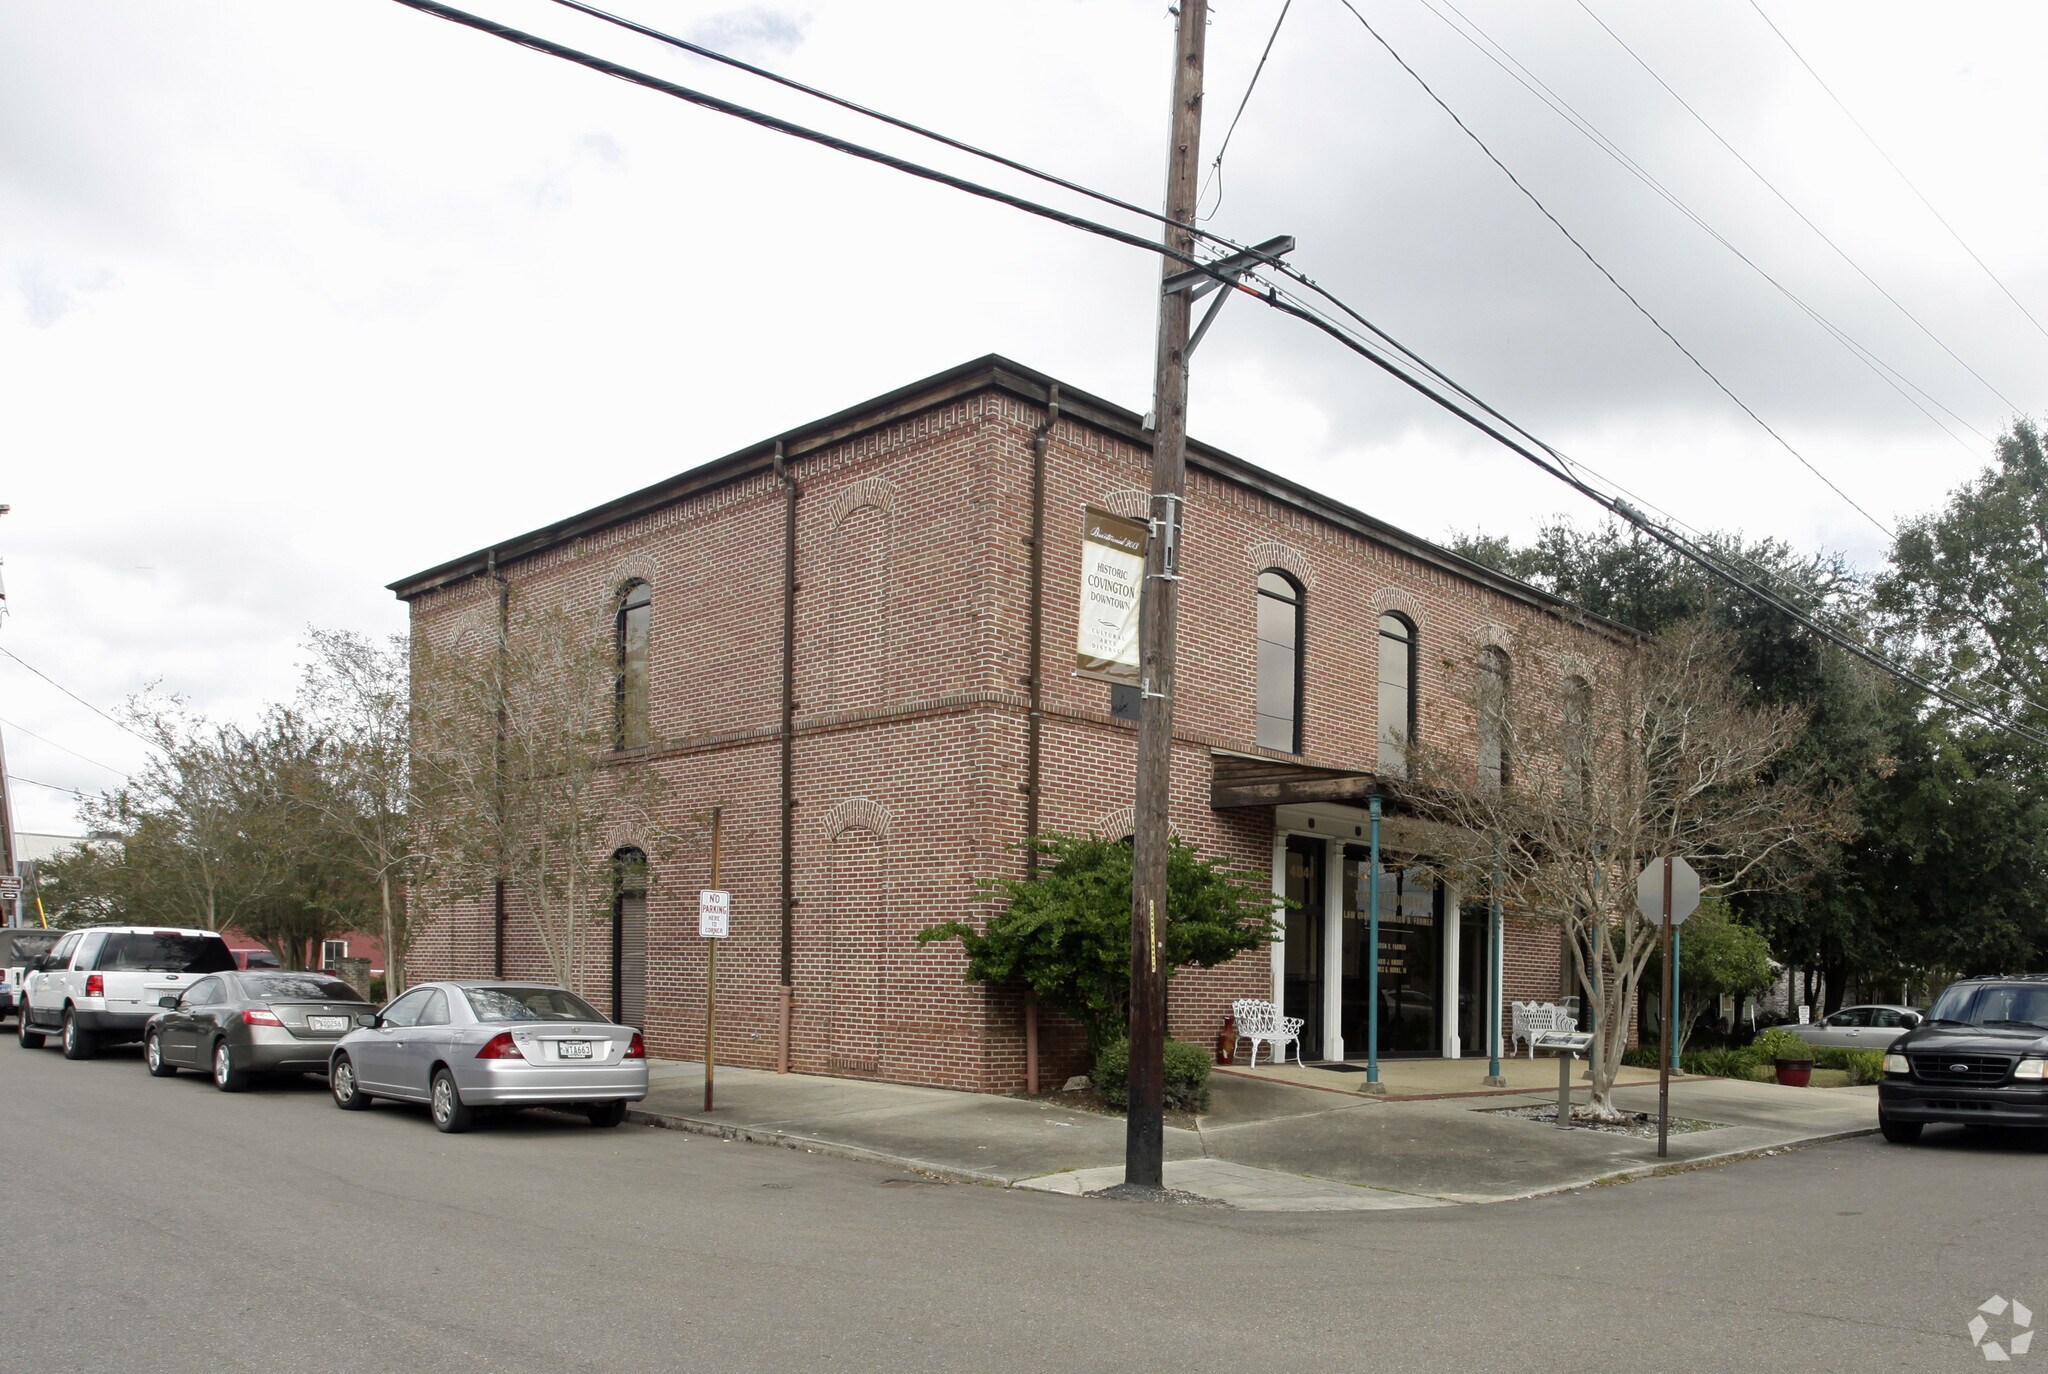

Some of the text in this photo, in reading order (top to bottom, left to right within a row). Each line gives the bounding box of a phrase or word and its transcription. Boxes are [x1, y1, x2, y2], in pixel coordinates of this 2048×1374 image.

[1090, 526, 1127, 546] Bicentennial
[1097, 562, 1128, 581] HISTORIC
[1087, 574, 1135, 599] COVINGTON
[1090, 591, 1131, 611] DOWNTOWN
[1091, 628, 1126, 642] CULTURAL
[1100, 637, 1117, 647] ARTS
[1091, 642, 1125, 656] DISTRICT
[710, 894, 720, 903] NO
[703, 905, 726, 914] PARKING
[1343, 910, 1356, 920] LAW
[564, 1045, 591, 1055] WTA663
